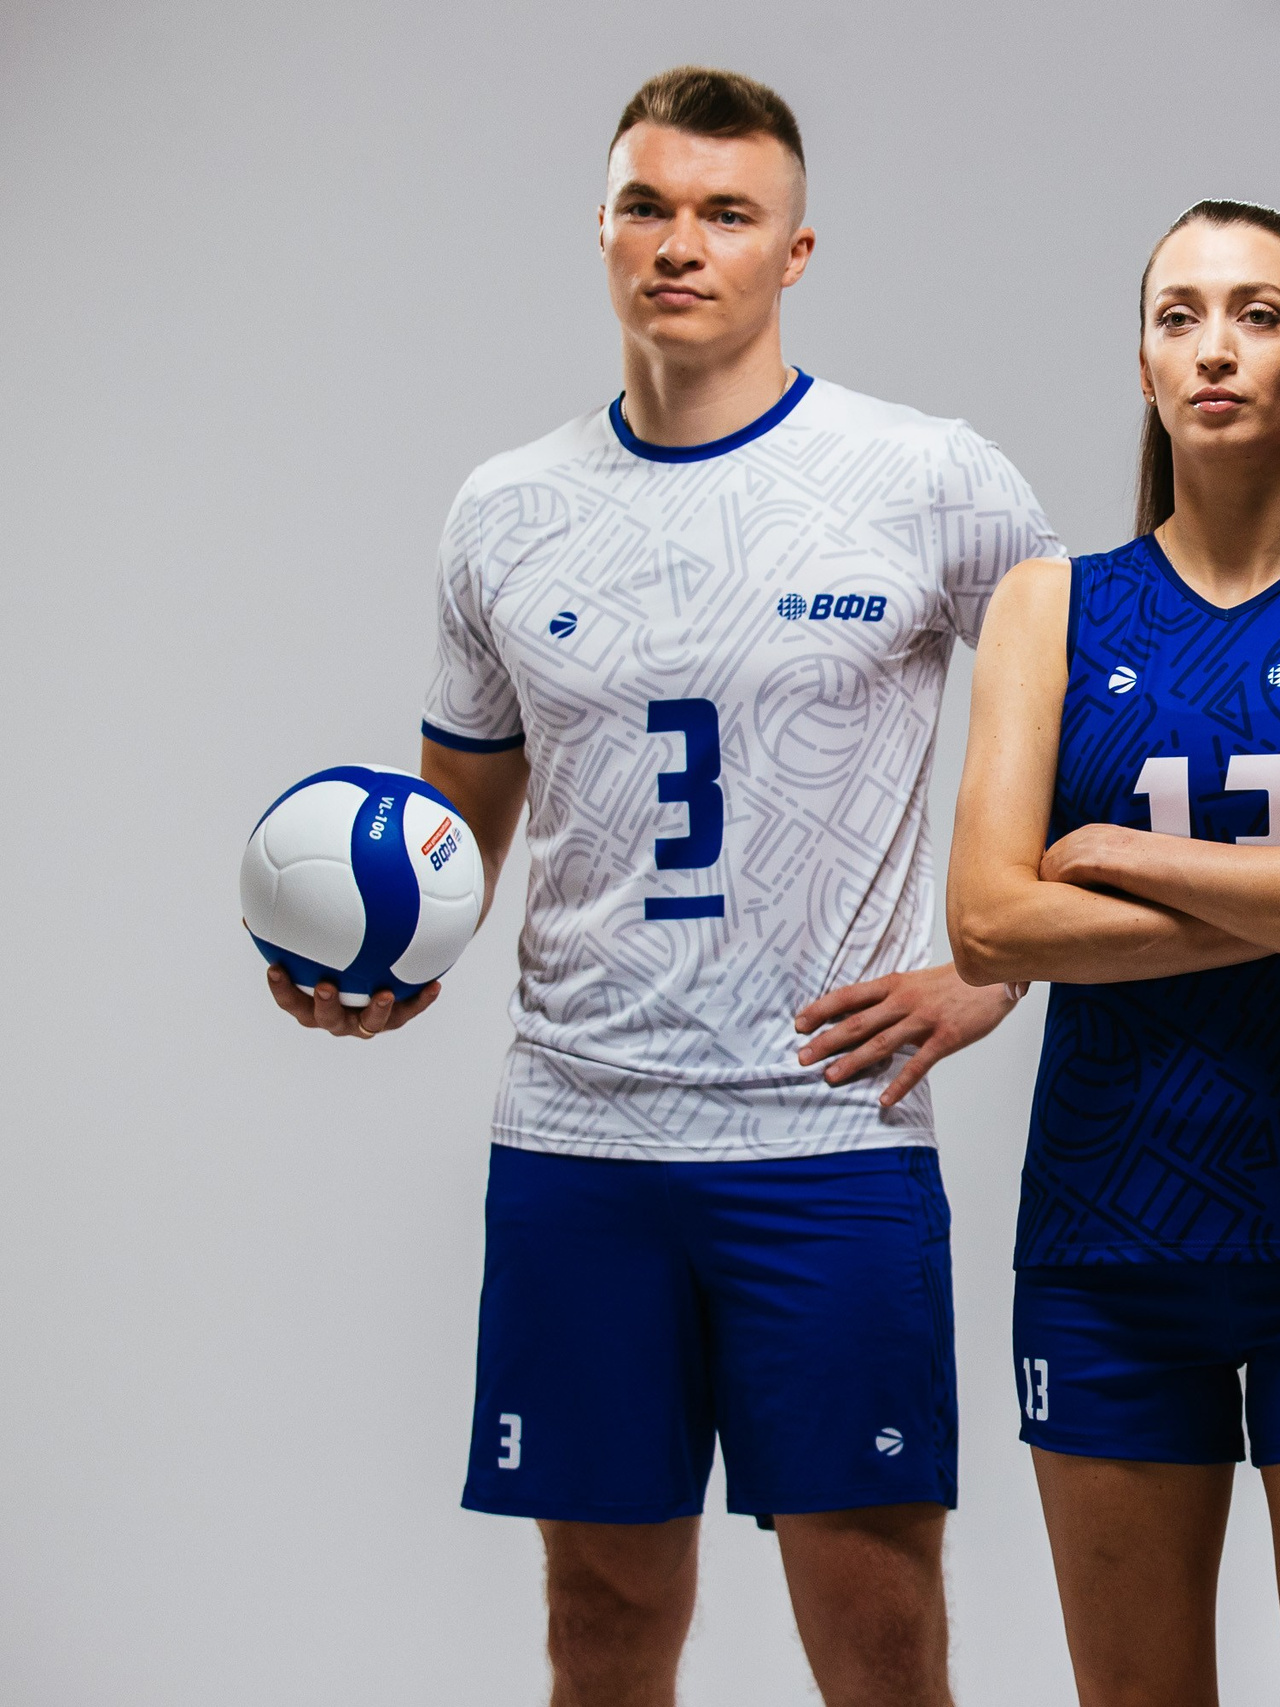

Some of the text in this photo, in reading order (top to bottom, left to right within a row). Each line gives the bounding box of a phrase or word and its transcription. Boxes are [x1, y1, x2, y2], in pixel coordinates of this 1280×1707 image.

[809, 593, 887, 622] ВФВ
[646, 697, 724, 870] 3
[369, 796, 395, 840] VL-100
[430, 834, 457, 871] ВФВ
[1023, 1357, 1049, 1421] 13
[498, 1412, 523, 1470] 3
